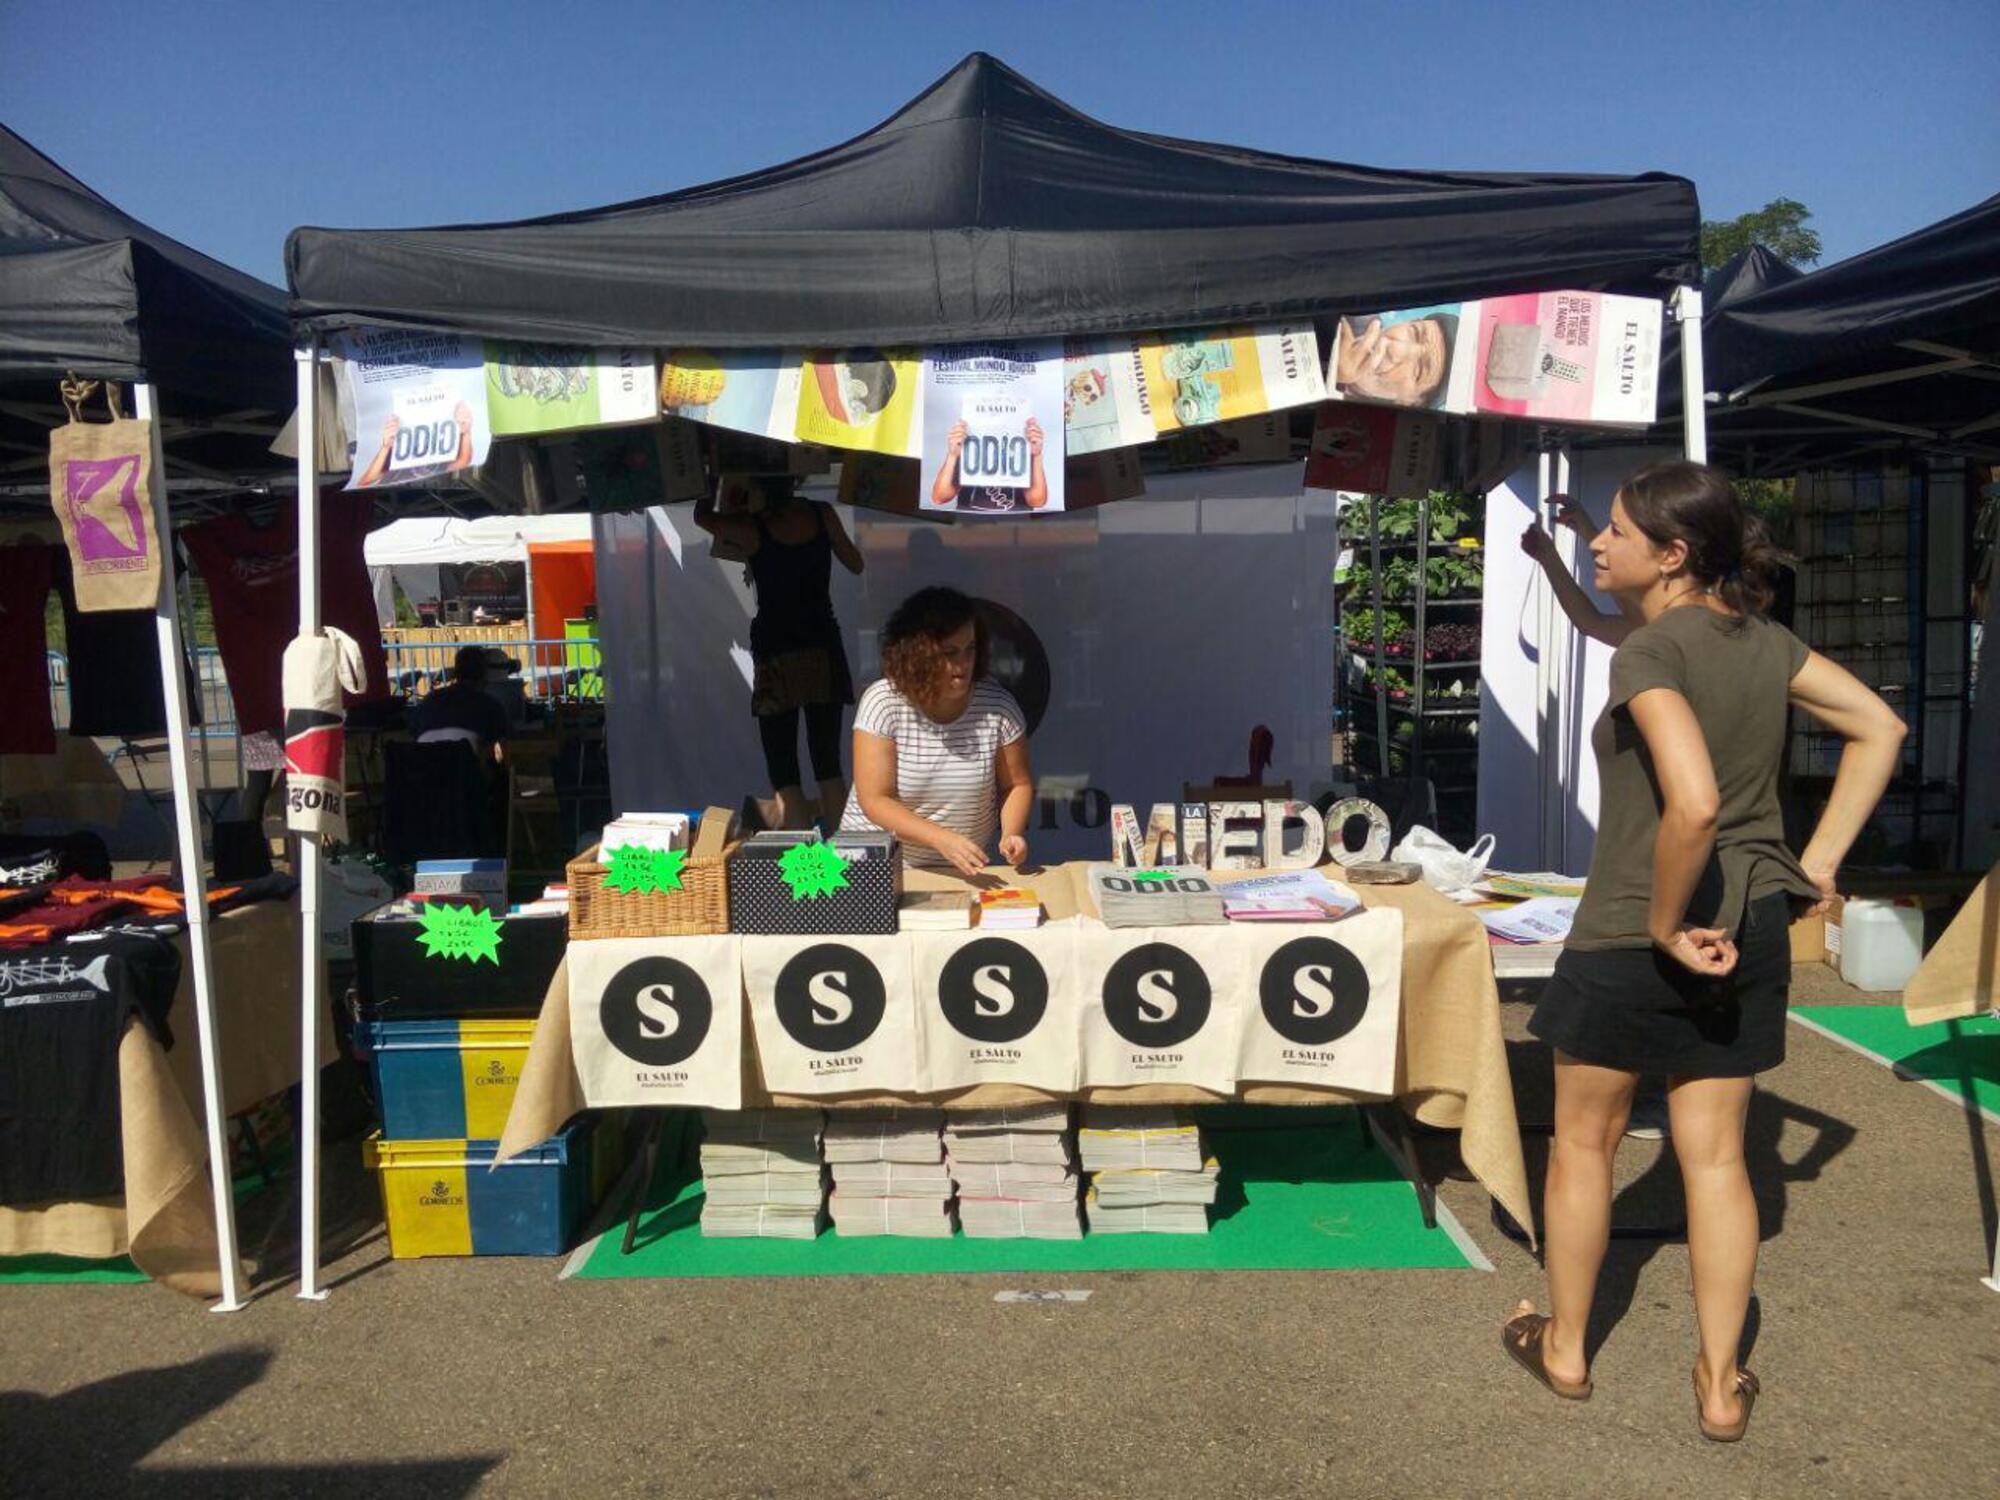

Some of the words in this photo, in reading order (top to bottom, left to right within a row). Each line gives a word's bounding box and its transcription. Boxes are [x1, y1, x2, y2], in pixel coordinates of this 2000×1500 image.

[1569, 298, 1580, 314] QUE
[1581, 298, 1592, 314] LOS
[1566, 315, 1578, 346] TIENEN
[1578, 315, 1590, 347] MEDIOS
[1625, 321, 1637, 340] EL
[622, 346, 633, 392] ALTO
[933, 360, 972, 373] FESTIVAL
[974, 360, 1006, 373] MUNDO
[1620, 345, 1637, 395] SALTO
[394, 420, 457, 461] ODIO
[963, 435, 1027, 477] ODIO
[1185, 807, 1202, 818] LA
[1110, 796, 1392, 871] MIEDO
[808, 970, 853, 1025] S
[972, 964, 1015, 1017] S
[1136, 970, 1178, 1023] S
[1292, 964, 1334, 1018] S
[636, 983, 680, 1039] S
[809, 1060, 823, 1069] EL
[825, 1056, 863, 1068] SALTO
[969, 1049, 982, 1058] EL
[986, 1048, 1022, 1059] SALTO
[1132, 1054, 1144, 1063] EL
[1148, 1053, 1183, 1063] SALTO
[1281, 1049, 1296, 1059] EL
[1298, 1050, 1335, 1062] SALTO
[636, 1072, 649, 1082] EL
[652, 1072, 689, 1082] SALTO
